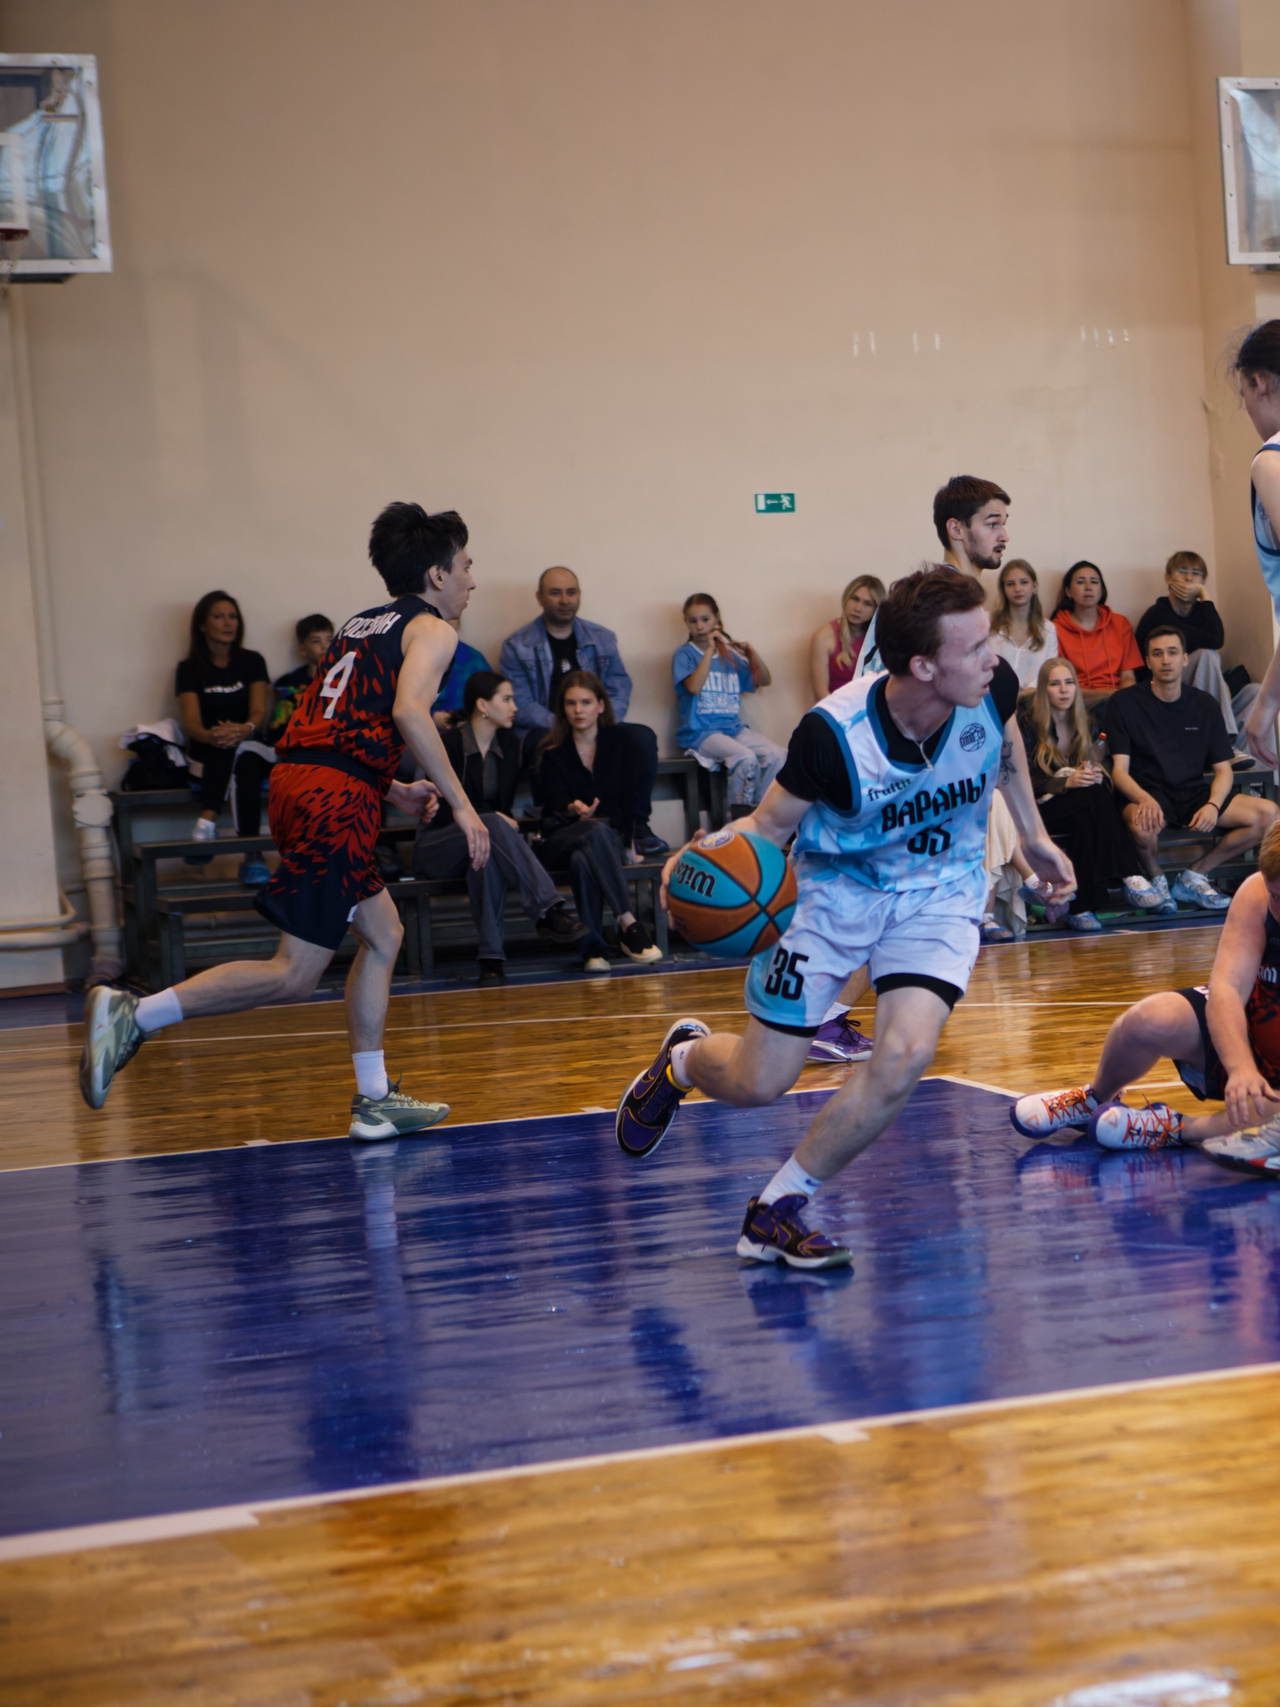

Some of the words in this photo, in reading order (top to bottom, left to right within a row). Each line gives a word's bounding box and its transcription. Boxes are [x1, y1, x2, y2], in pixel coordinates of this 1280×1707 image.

[319, 650, 358, 720] 4
[881, 772, 987, 834] ВАРАНЫ
[676, 861, 716, 898] Wils
[764, 947, 810, 1001] 35
